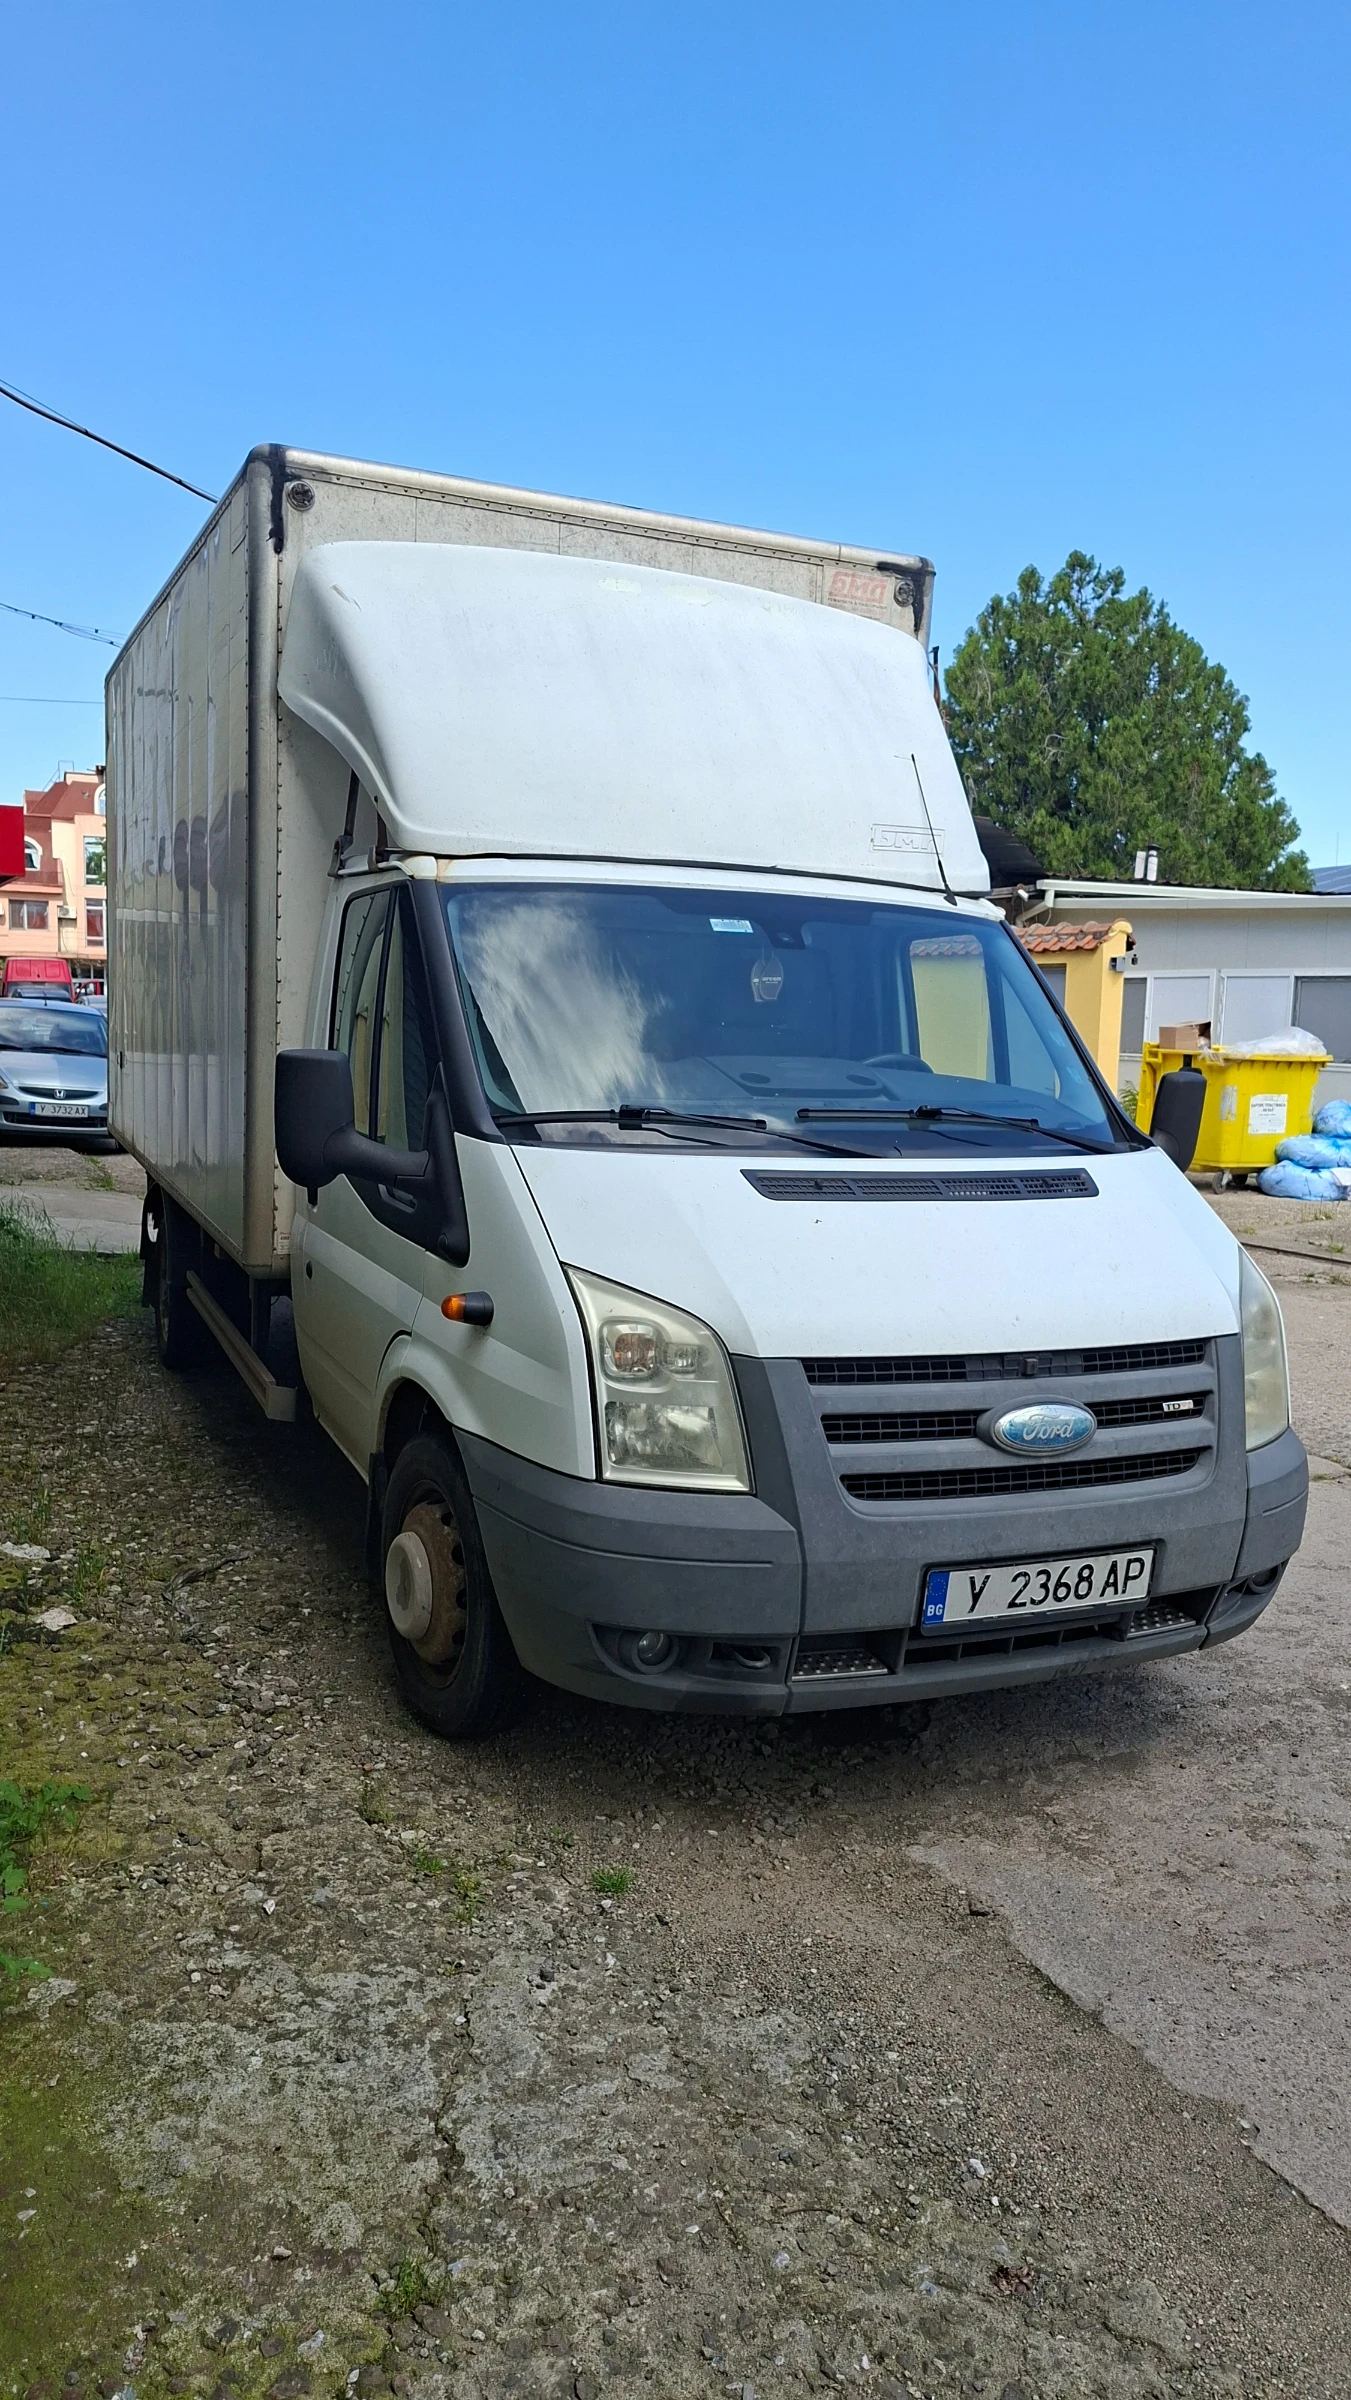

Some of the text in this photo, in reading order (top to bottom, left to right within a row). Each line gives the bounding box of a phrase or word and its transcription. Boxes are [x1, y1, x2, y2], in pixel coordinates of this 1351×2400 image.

[50, 1105, 73, 1115] 3732
[1022, 1413, 1075, 1442] Ford
[1006, 1563, 1095, 1610] 2368
[1099, 1556, 1146, 1598] AP
[926, 1604, 943, 1617] BG
